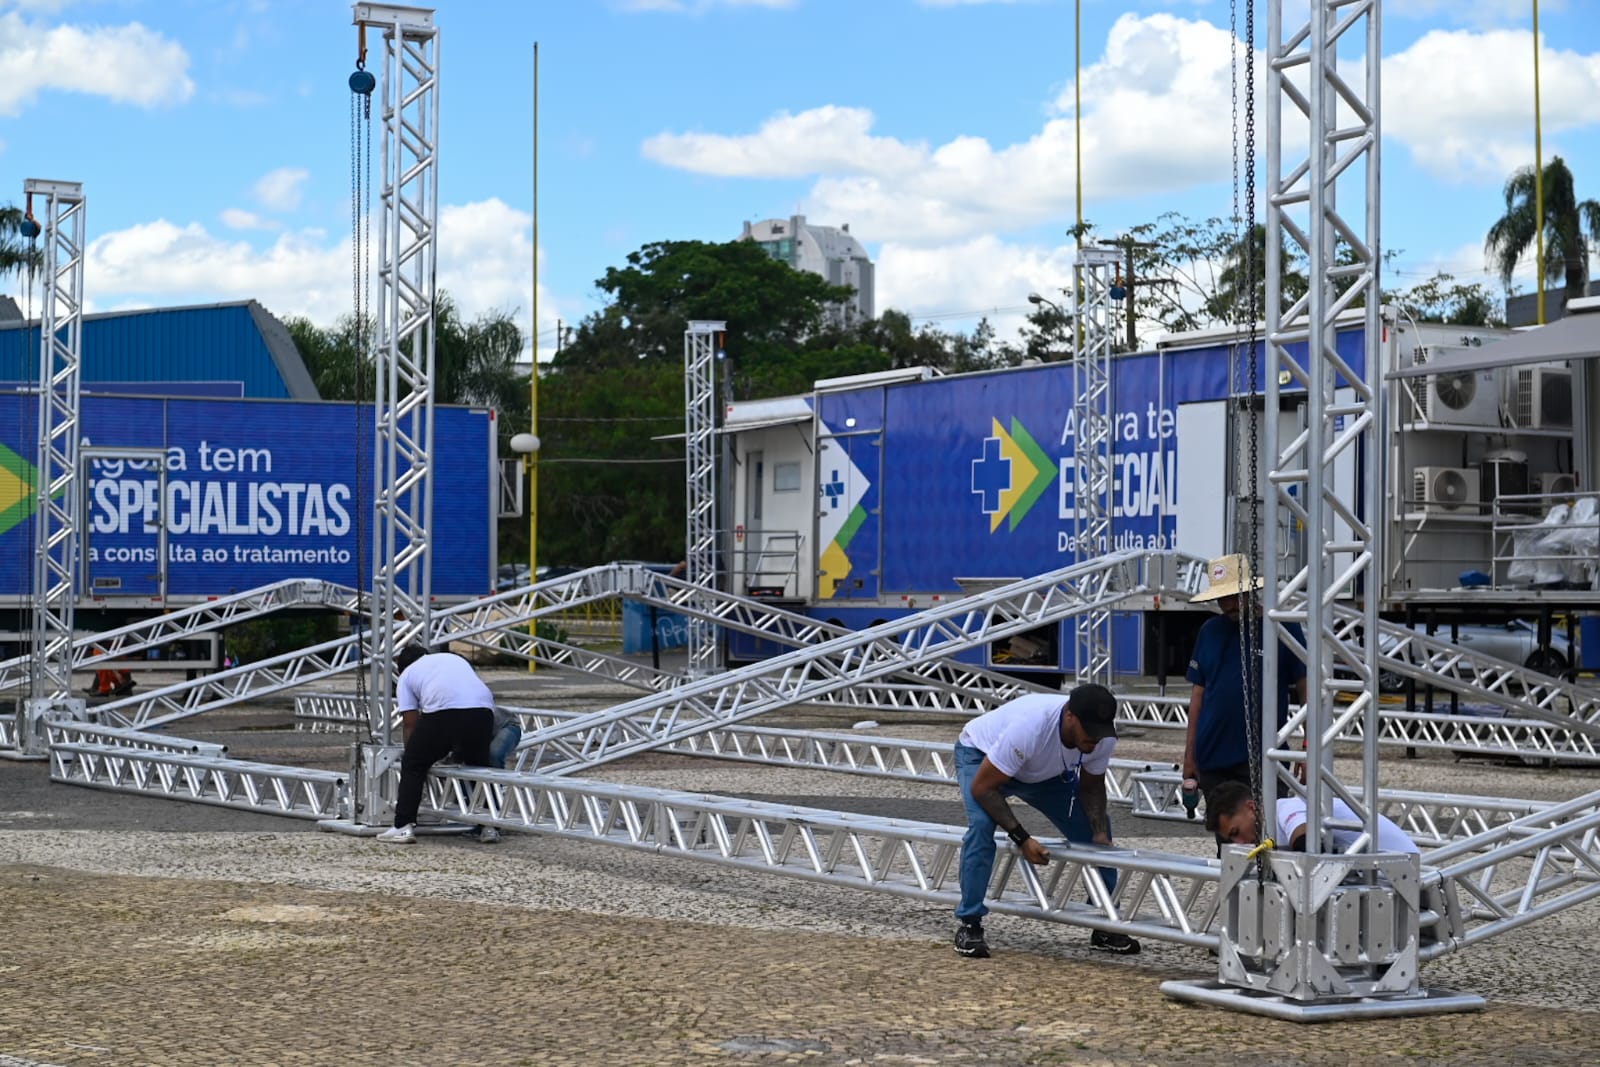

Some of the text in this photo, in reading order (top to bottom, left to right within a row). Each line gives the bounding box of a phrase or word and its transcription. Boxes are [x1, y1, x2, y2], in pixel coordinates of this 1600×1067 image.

[198, 440, 272, 473] tem
[1147, 534, 1167, 550] ao
[202, 548, 228, 563] ao
[233, 544, 351, 564] tratamento
